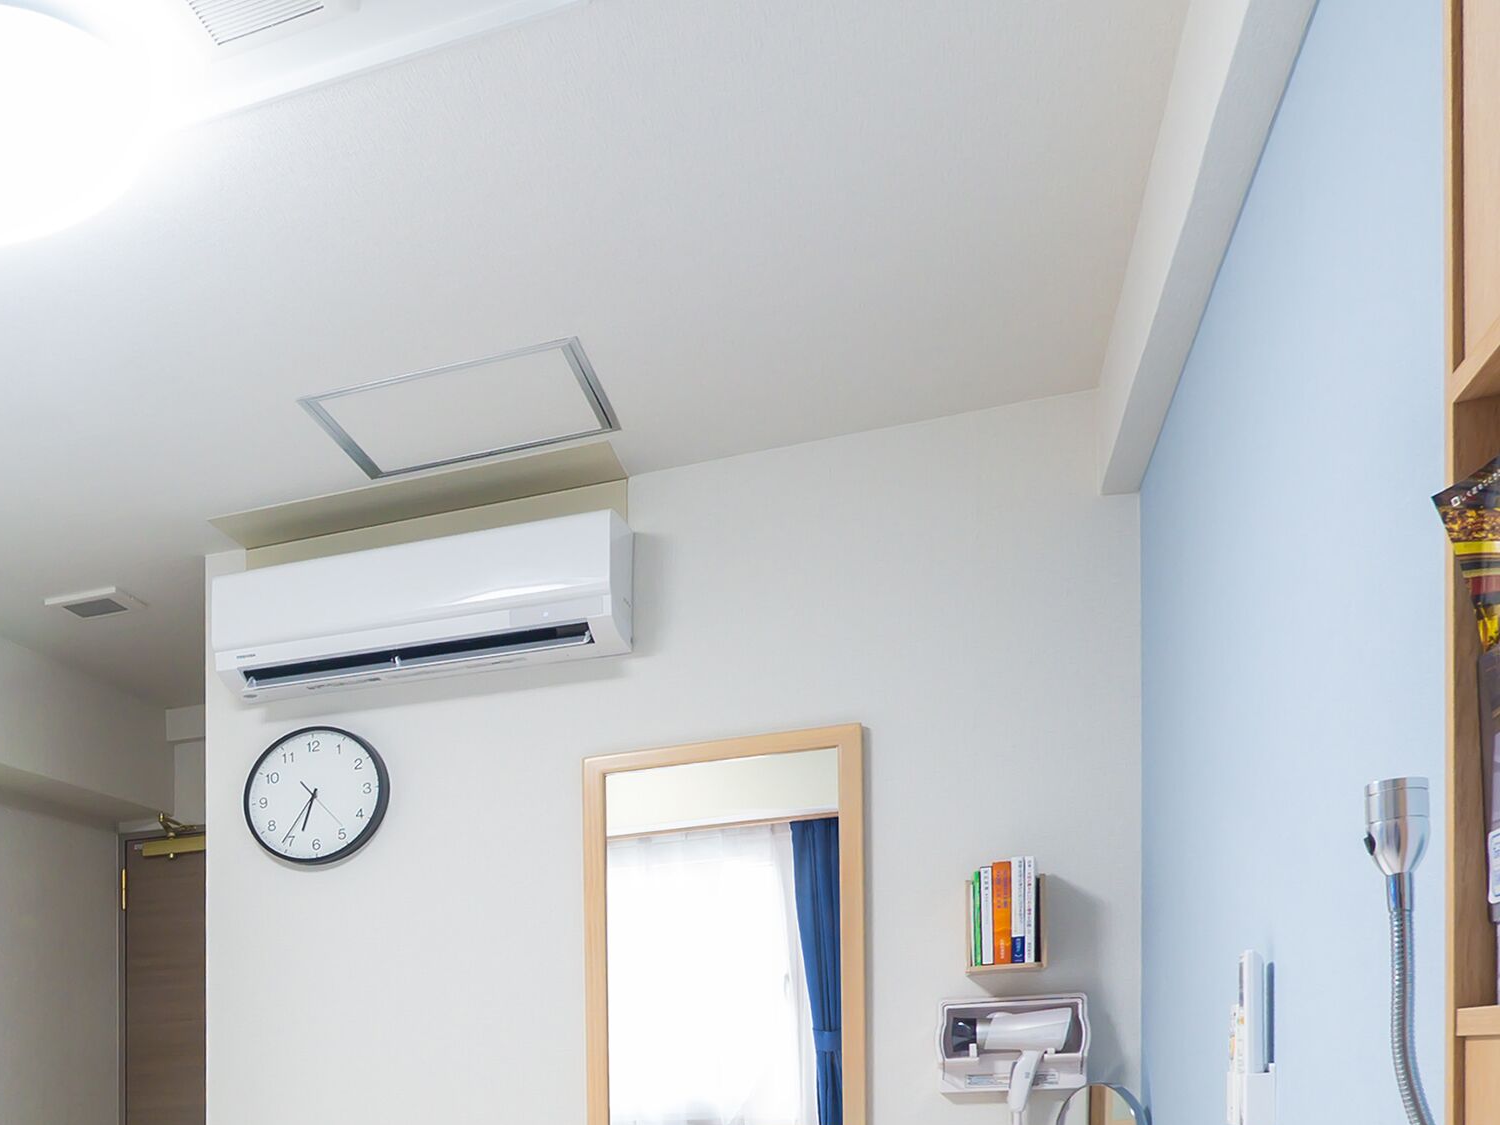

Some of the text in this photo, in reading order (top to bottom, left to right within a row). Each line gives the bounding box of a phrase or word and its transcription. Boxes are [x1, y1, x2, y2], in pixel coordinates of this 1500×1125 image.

[307, 740, 321, 753] 12
[336, 744, 342, 755] 1
[282, 752, 295, 764] 11
[354, 758, 363, 770] 2
[266, 772, 280, 785] 10
[362, 782, 372, 795] 3
[259, 797, 268, 809] 9
[355, 808, 364, 819] 4
[267, 820, 277, 832] 8
[337, 828, 347, 841] 5
[287, 835, 295, 847] 7
[311, 838, 321, 851] 6
